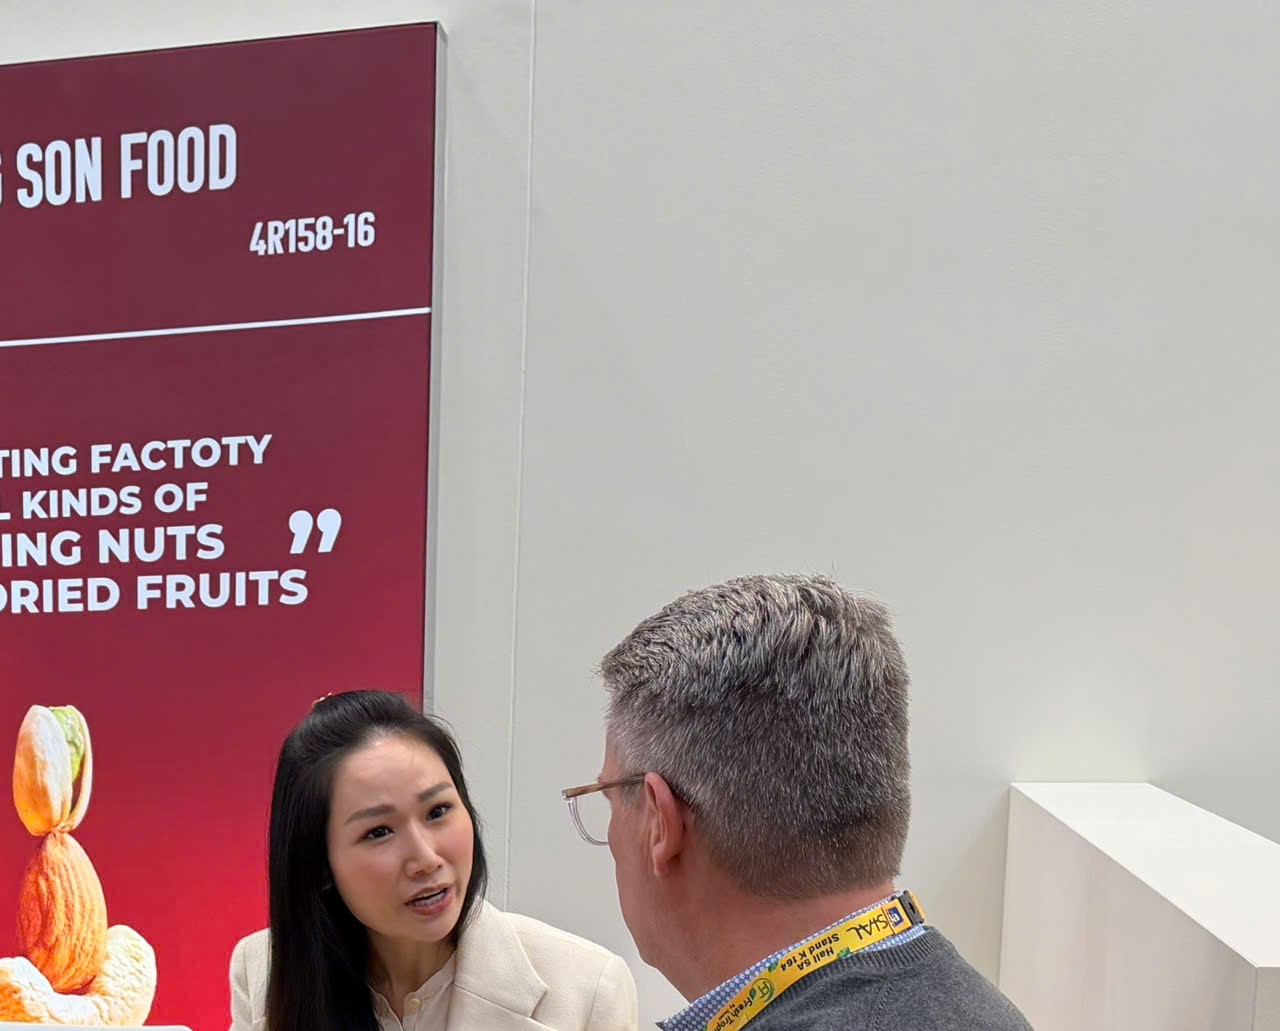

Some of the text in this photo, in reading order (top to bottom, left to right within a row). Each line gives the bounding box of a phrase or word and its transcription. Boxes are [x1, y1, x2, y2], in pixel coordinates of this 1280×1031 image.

[16, 136, 103, 209] SON
[120, 123, 237, 199] FOOD
[249, 211, 376, 256] 4R158-16
[90, 434, 273, 473] FACTOTY
[22, 485, 143, 519] KINDS
[154, 482, 209, 513] OF
[98, 523, 225, 564] NUTS
[137, 568, 309, 610] FRUITS
[798, 950, 807, 961] K
[808, 933, 840, 951] Stand
[814, 946, 835, 964] Hall
